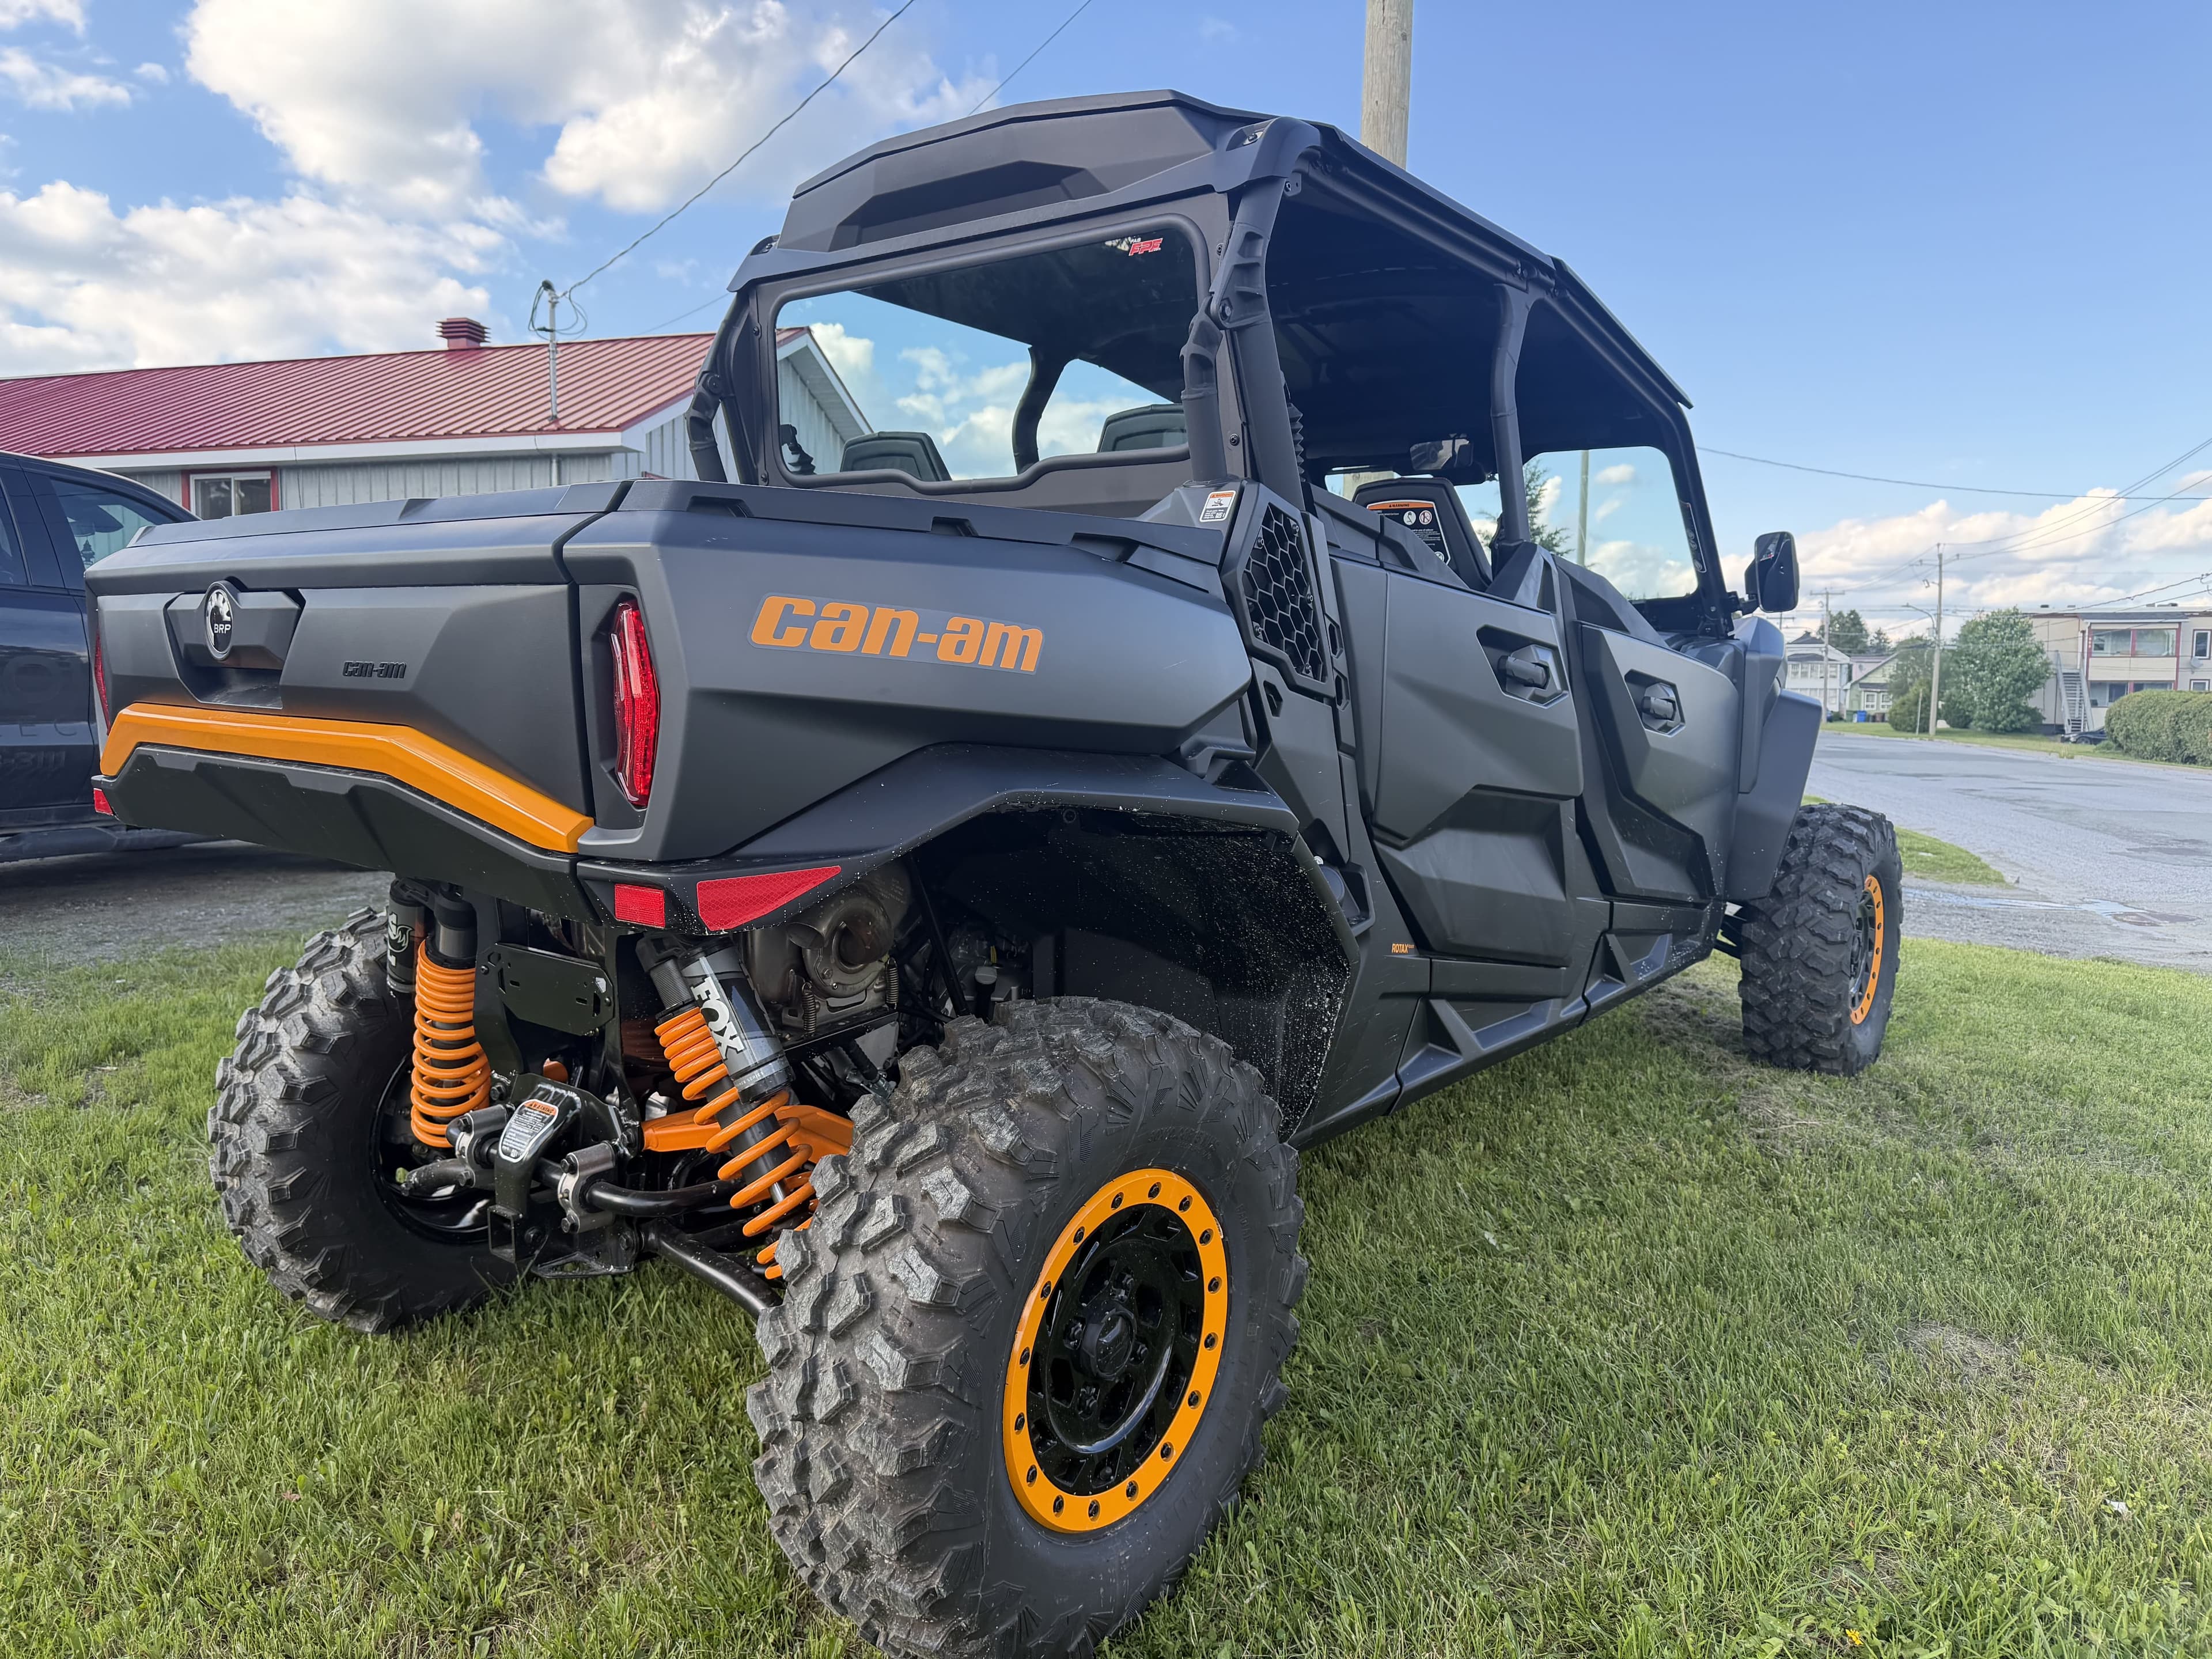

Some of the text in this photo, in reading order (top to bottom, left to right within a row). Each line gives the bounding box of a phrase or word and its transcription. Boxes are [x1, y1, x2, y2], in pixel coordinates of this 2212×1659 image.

[214, 623, 232, 634] BRP
[1392, 943, 1408, 953] ROTAX
[691, 976, 744, 1060] FOX
